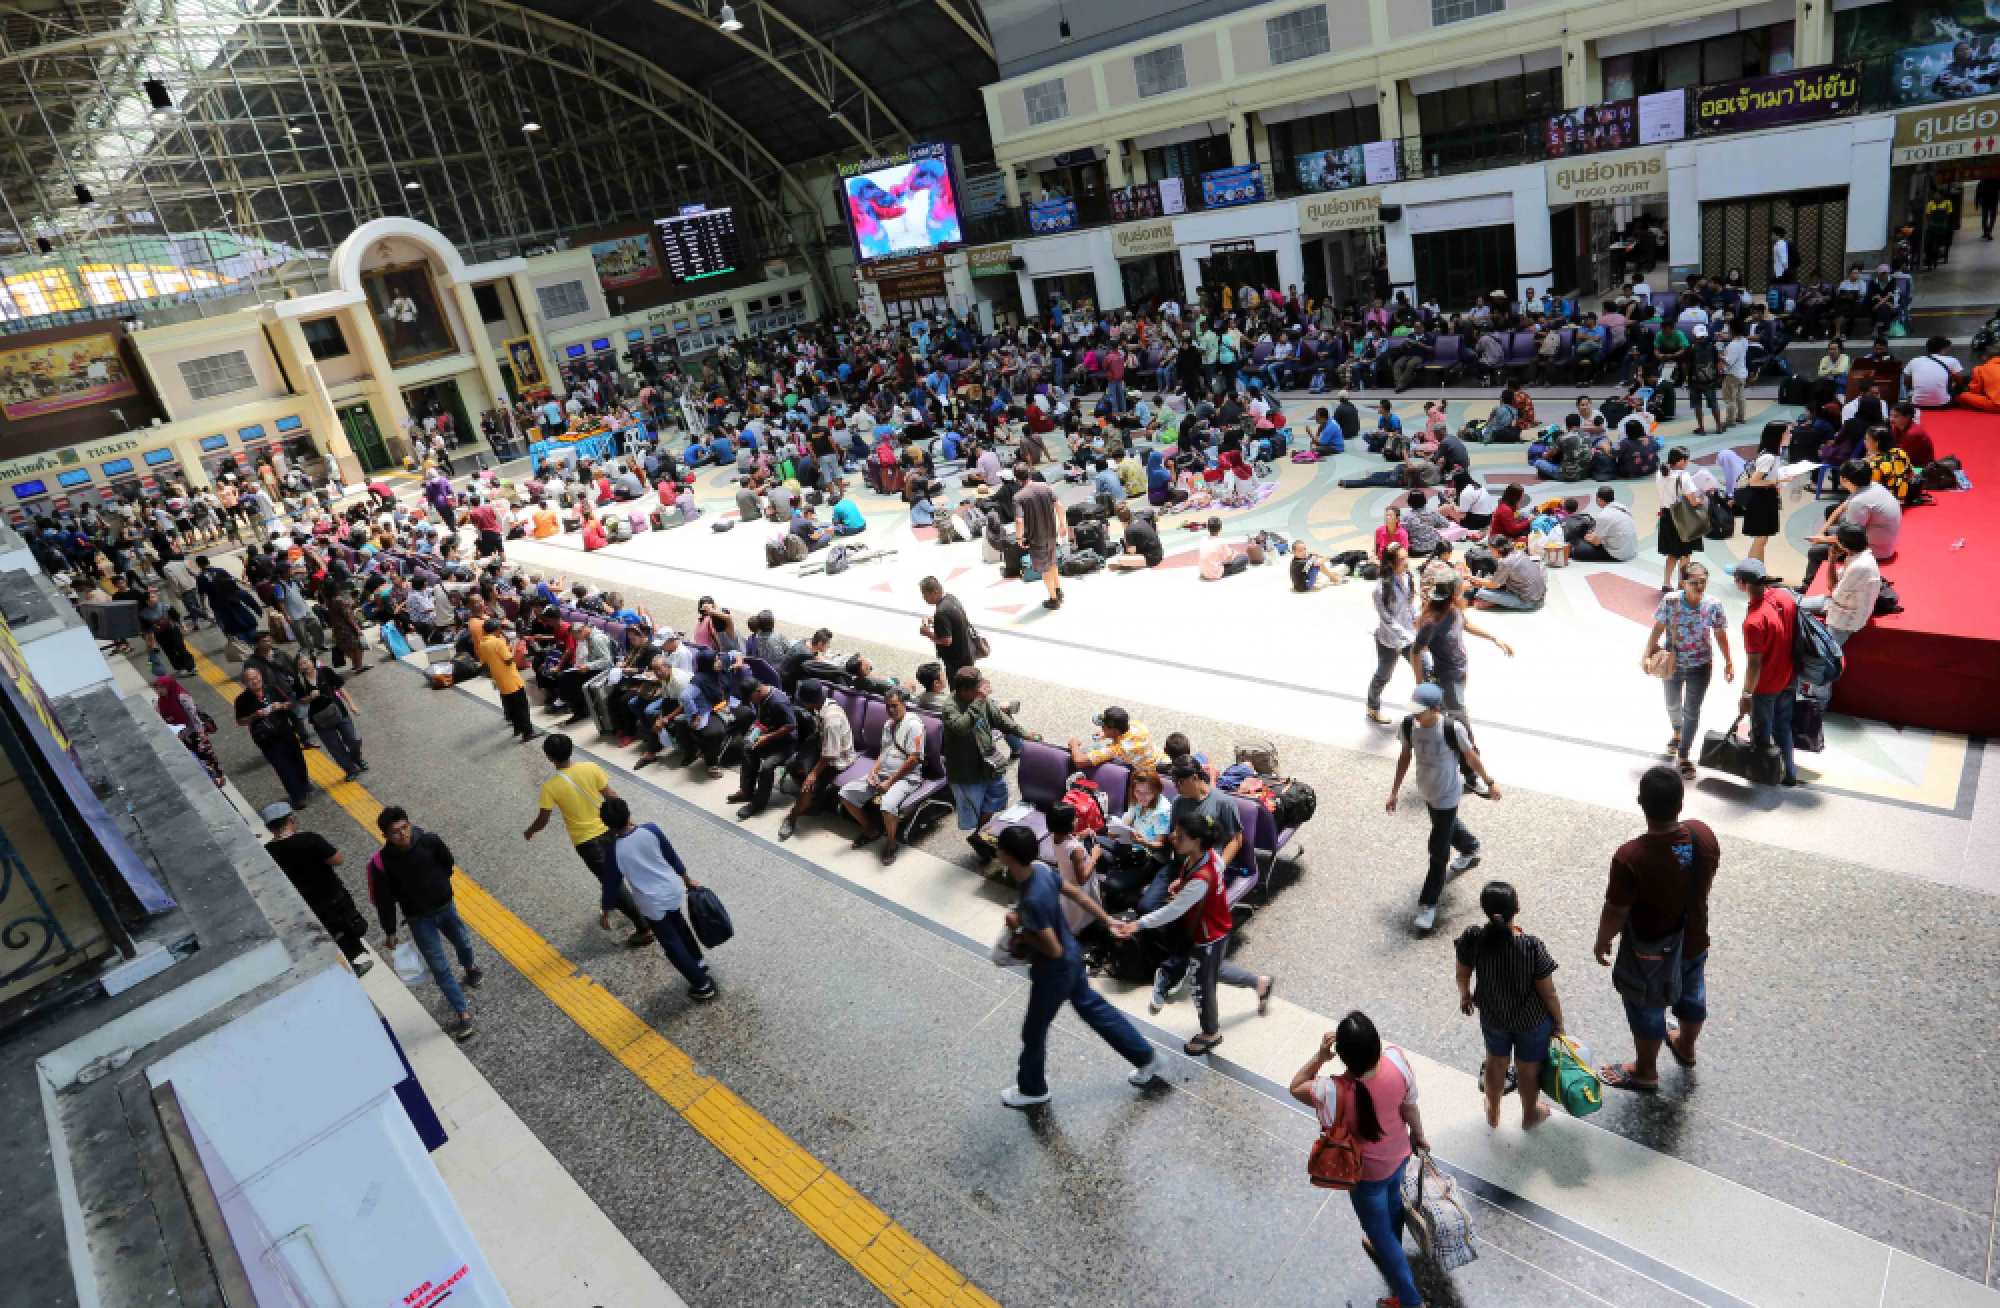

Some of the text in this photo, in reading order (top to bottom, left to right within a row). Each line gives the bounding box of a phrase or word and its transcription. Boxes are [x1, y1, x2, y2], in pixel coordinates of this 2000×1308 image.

[1903, 51, 1954, 71] CAN
[1901, 69, 1953, 89] SEE
[1551, 129, 1585, 145] SEE
[1903, 143, 1969, 161] TOILET
[1557, 158, 1661, 191] ศูนย์อาหาร
[1575, 180, 1650, 199] FOOD COURT
[1307, 196, 1382, 222] ศูนย์อาหาร
[1322, 213, 1375, 229] FOOD COURT
[86, 439, 139, 458] TICKETS
